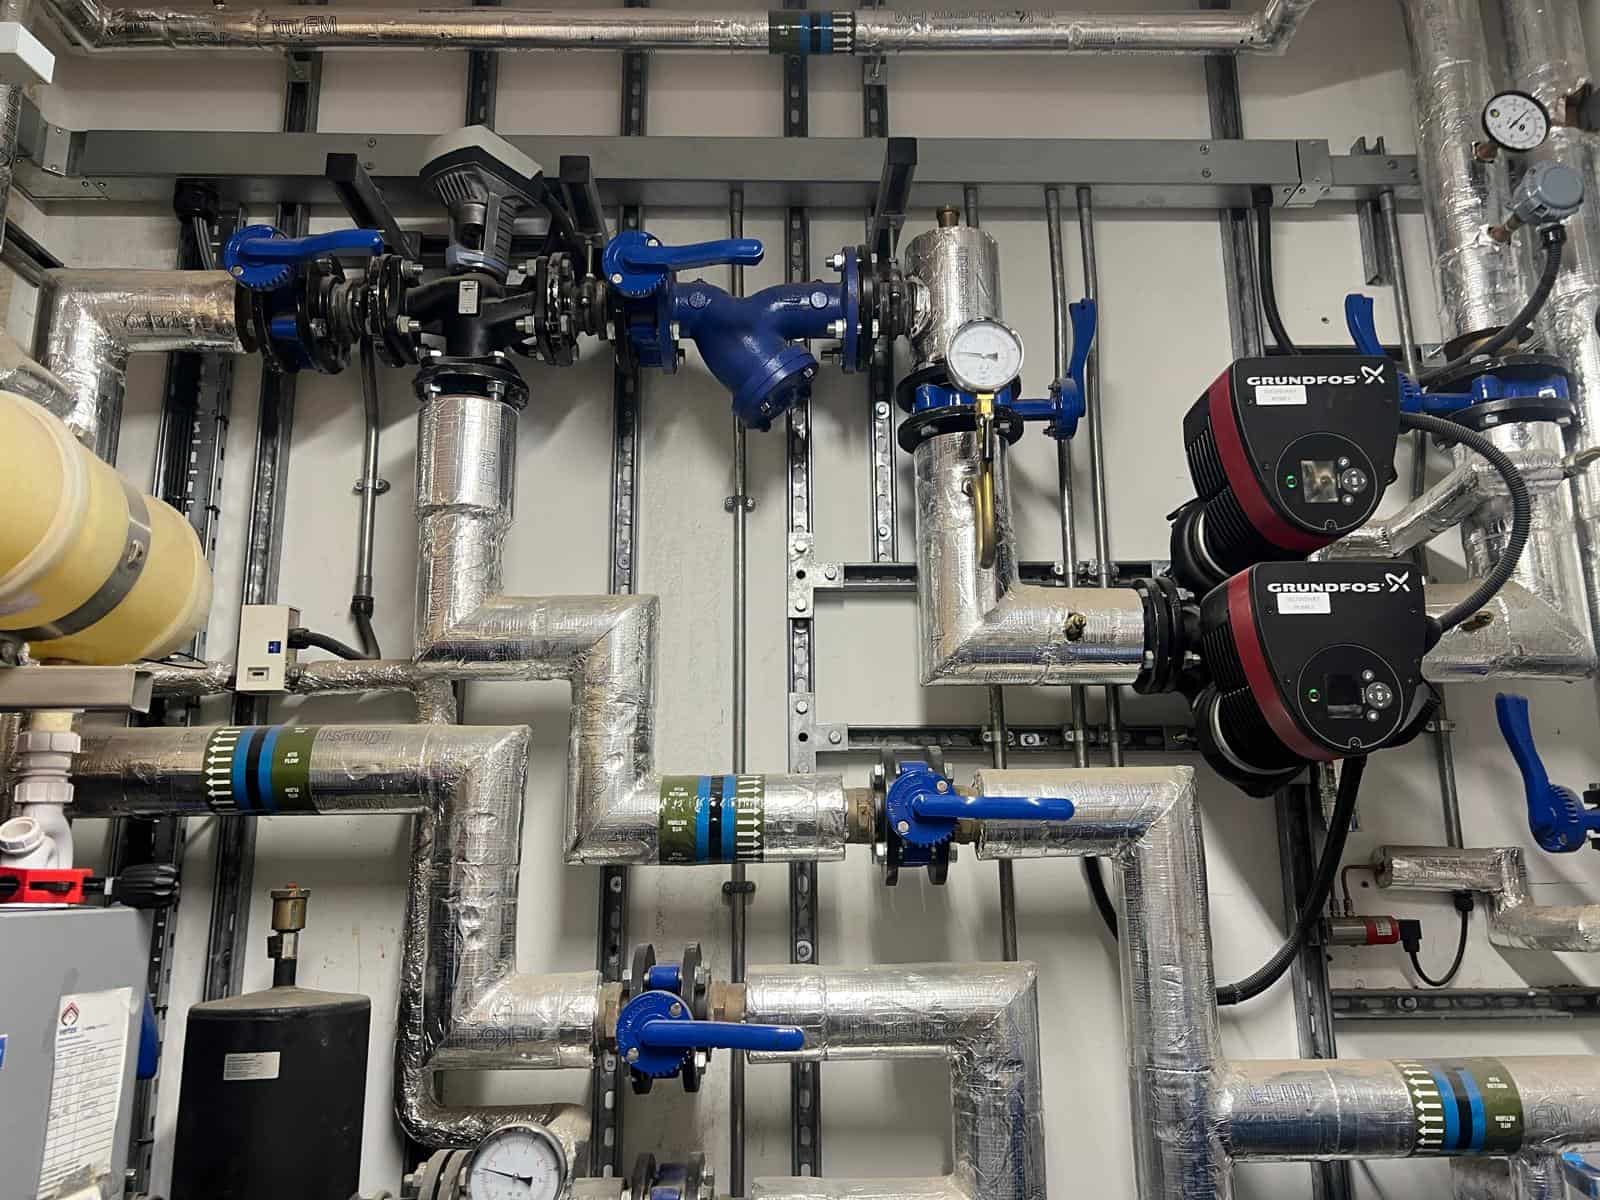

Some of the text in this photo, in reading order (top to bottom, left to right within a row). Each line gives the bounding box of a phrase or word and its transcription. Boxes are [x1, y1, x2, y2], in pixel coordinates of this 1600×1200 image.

[1247, 375, 1356, 386] GRUNDFOS
[1267, 582, 1381, 593] GRUNDFOS
[1531, 1104, 1572, 1128] FM
